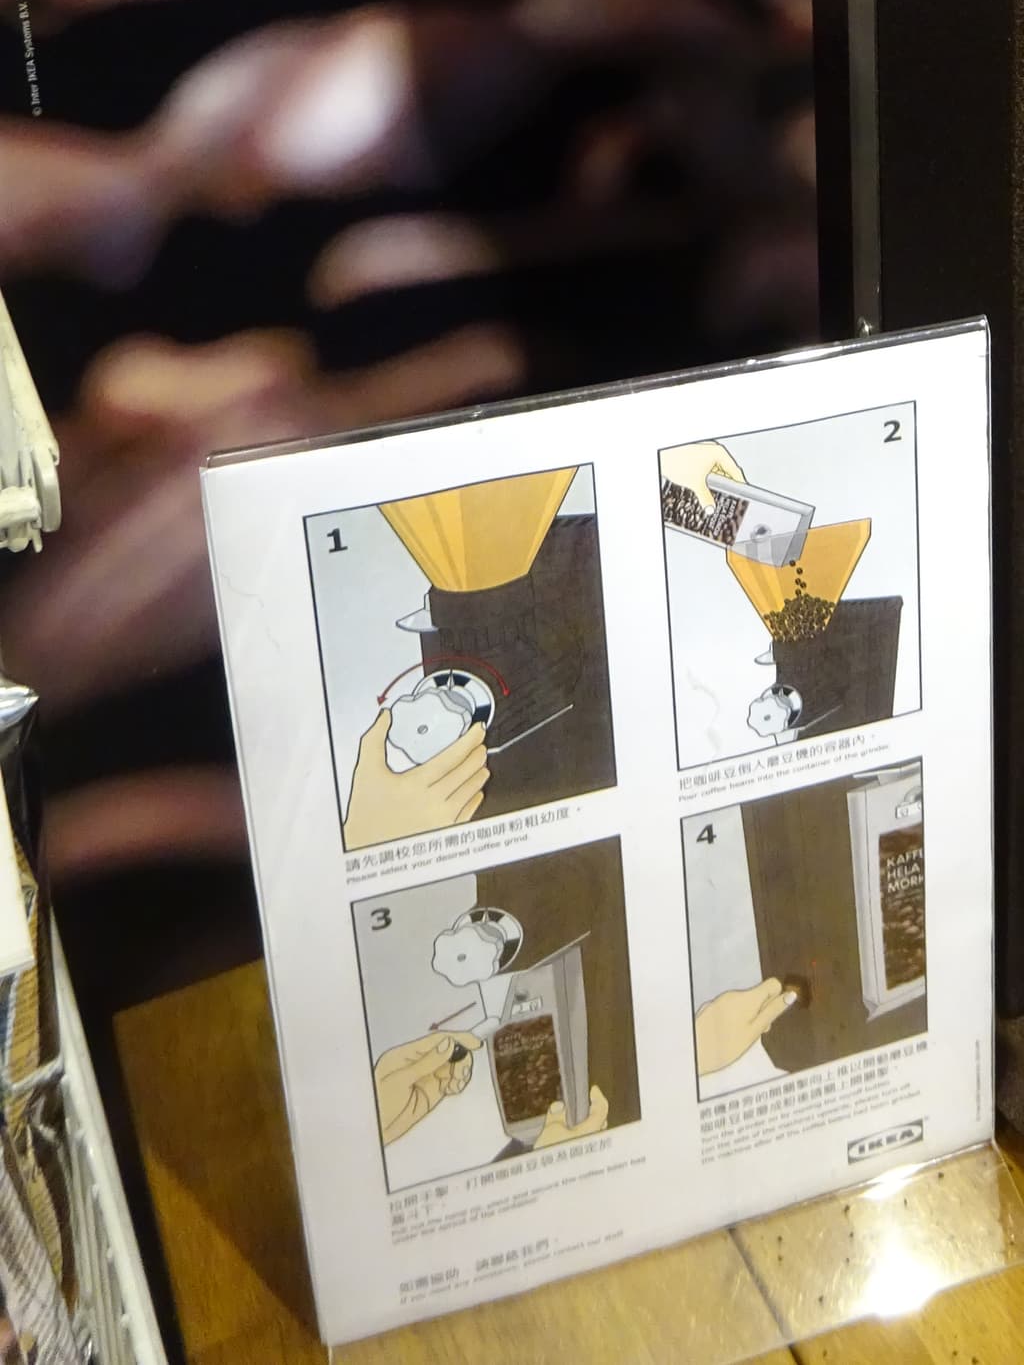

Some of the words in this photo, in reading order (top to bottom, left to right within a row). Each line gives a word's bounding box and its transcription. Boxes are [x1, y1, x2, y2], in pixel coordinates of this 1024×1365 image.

[26, 59, 38, 82] IKEA
[884, 419, 902, 443] 2
[326, 527, 349, 553] 1
[696, 823, 717, 844] 4
[371, 907, 392, 931] 3
[858, 1129, 915, 1155] IKEA
